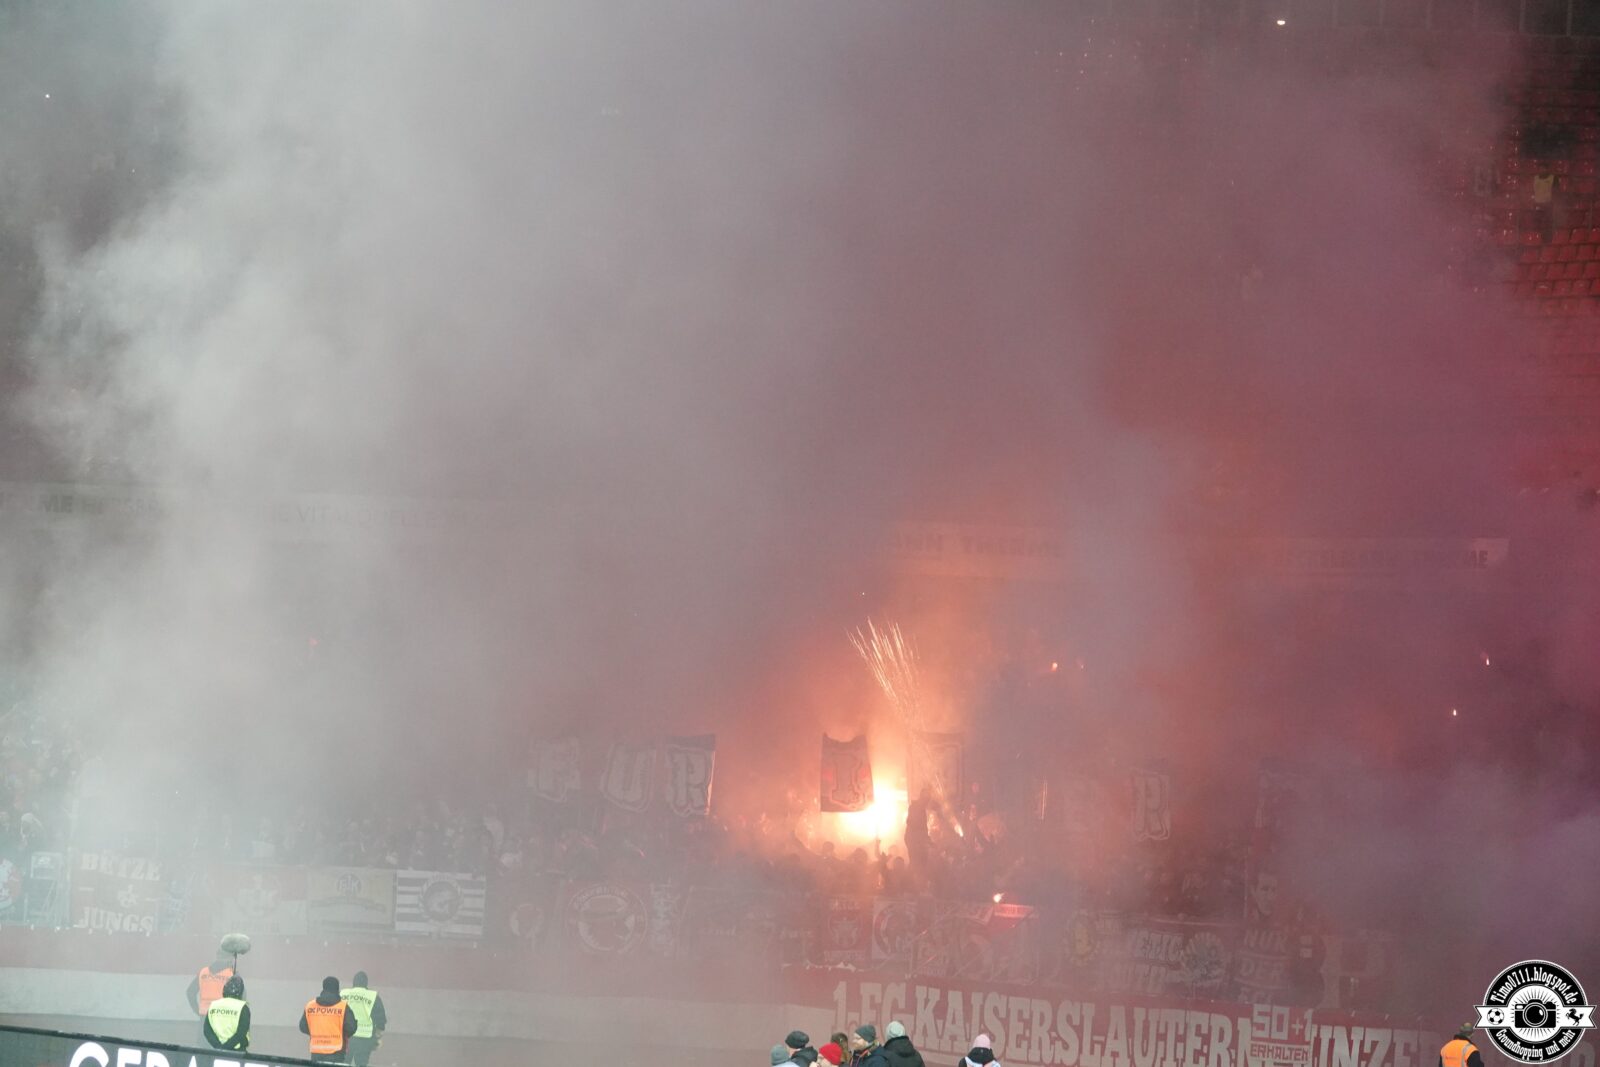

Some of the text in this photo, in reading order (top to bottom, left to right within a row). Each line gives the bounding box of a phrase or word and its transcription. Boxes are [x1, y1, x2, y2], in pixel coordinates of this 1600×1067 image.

[81, 853, 162, 881] BETZE
[73, 906, 155, 932] JUNGS
[1252, 1003, 1315, 1041] 50+1
[1250, 1042, 1310, 1062] ERHALTEN
